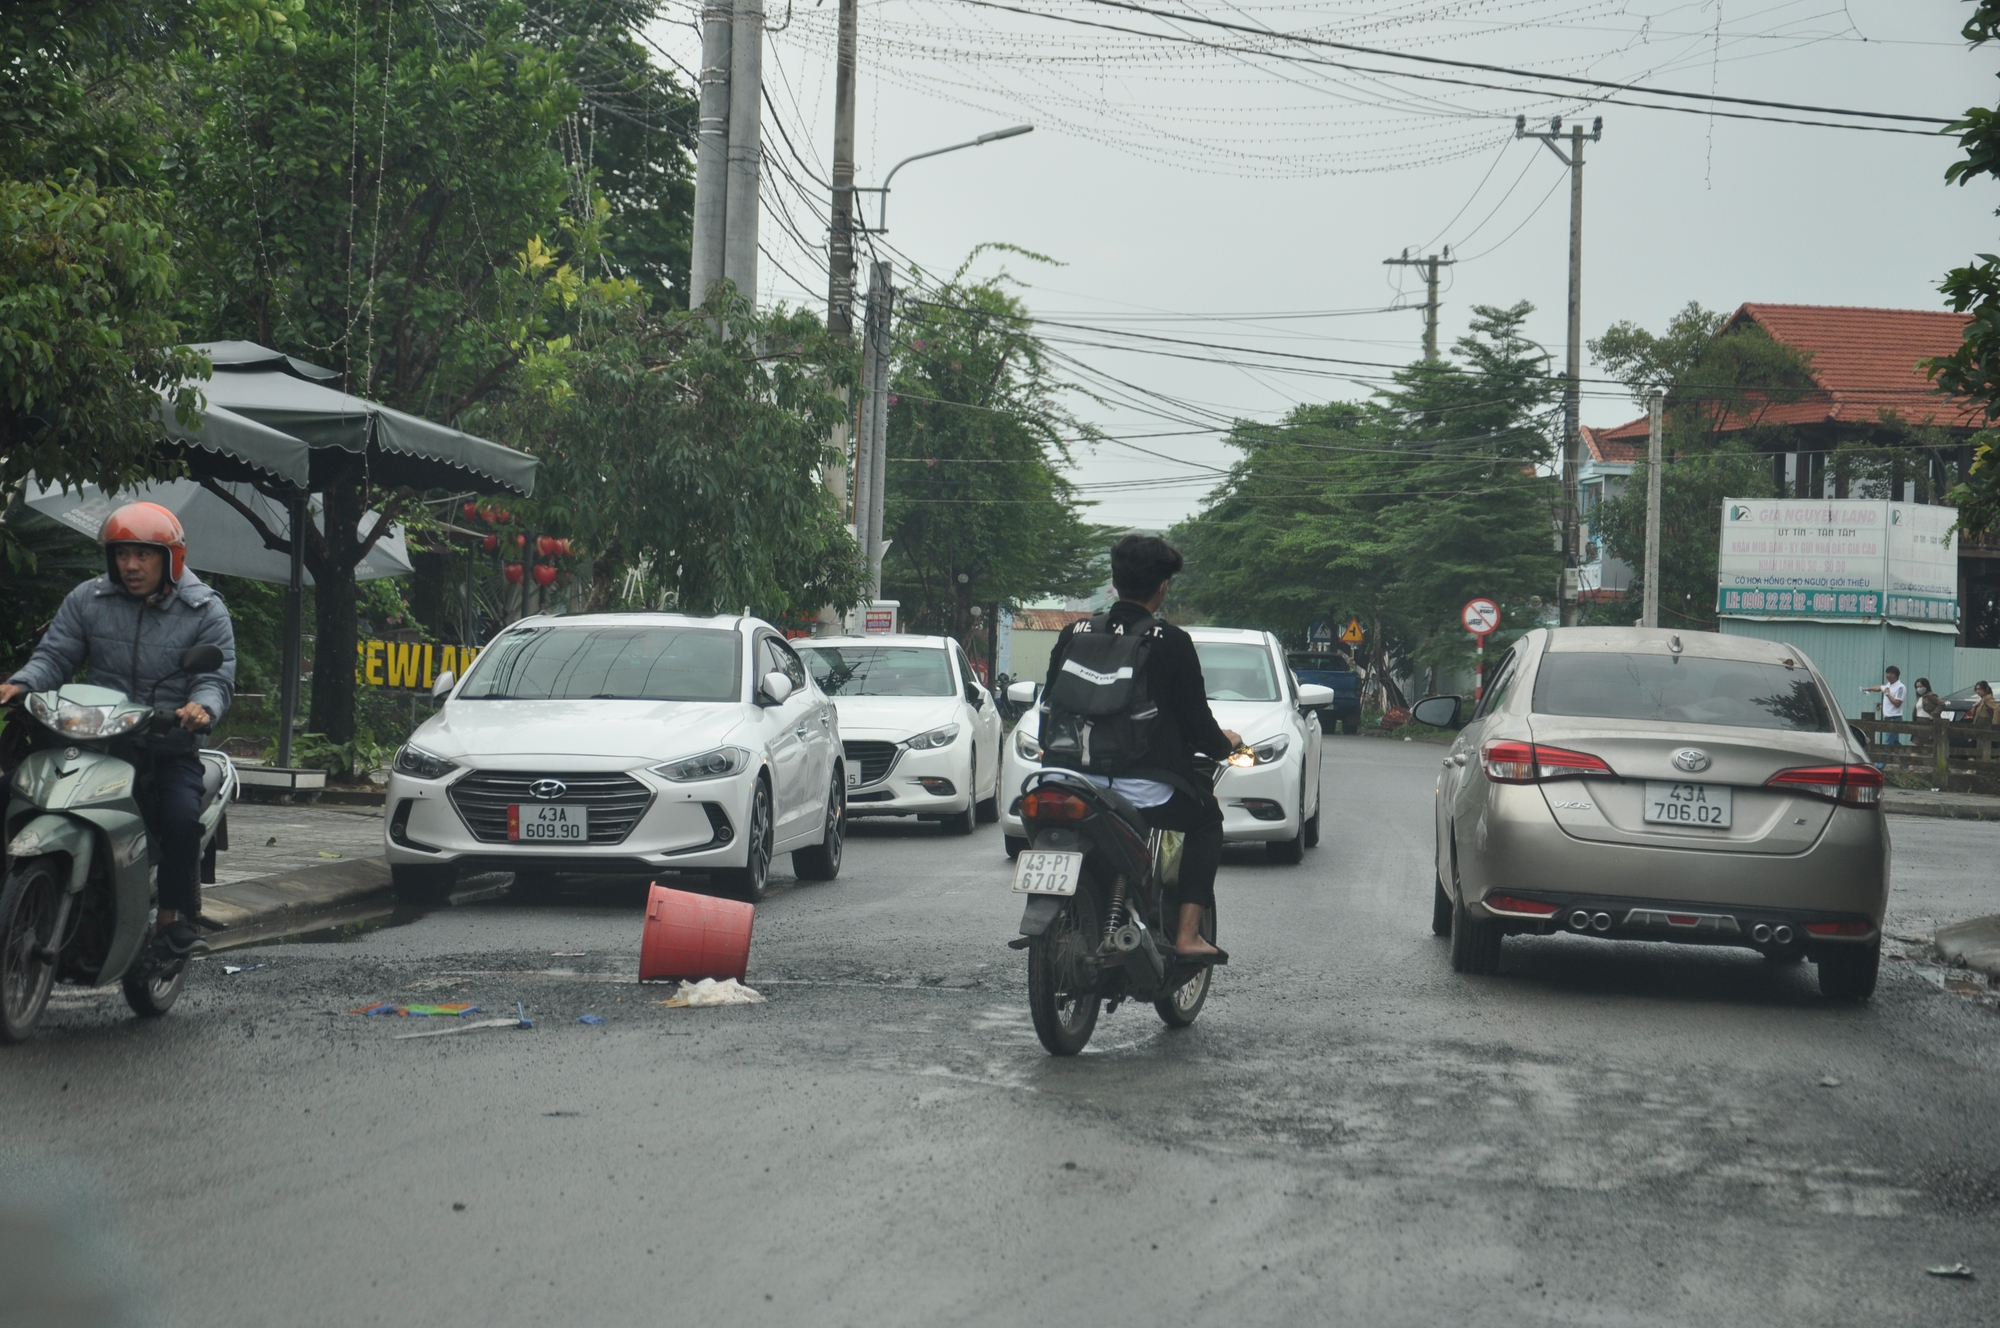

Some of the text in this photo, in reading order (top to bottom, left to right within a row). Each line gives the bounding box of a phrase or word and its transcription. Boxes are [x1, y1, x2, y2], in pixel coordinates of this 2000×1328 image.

[1759, 508, 1781, 523] GIA
[1841, 509, 1878, 524] LAND
[1778, 528, 1789, 537] UY
[1862, 543, 1877, 556] CAO
[1747, 576, 1762, 585] HOA
[1786, 577, 1803, 587] CHO
[1741, 592, 1764, 610] 0906
[1766, 592, 1778, 610] 22
[1779, 593, 1792, 610] 22
[1793, 592, 1806, 611] 92
[1838, 594, 1857, 612] 912
[1670, 784, 1707, 803] 43A
[1553, 800, 1592, 810] VIOS
[538, 807, 567, 822] 43A
[1654, 802, 1722, 824] 706.02
[526, 823, 580, 838] 609.90
[1026, 854, 1071, 873] 43-P1
[1021, 872, 1068, 892] 6702
